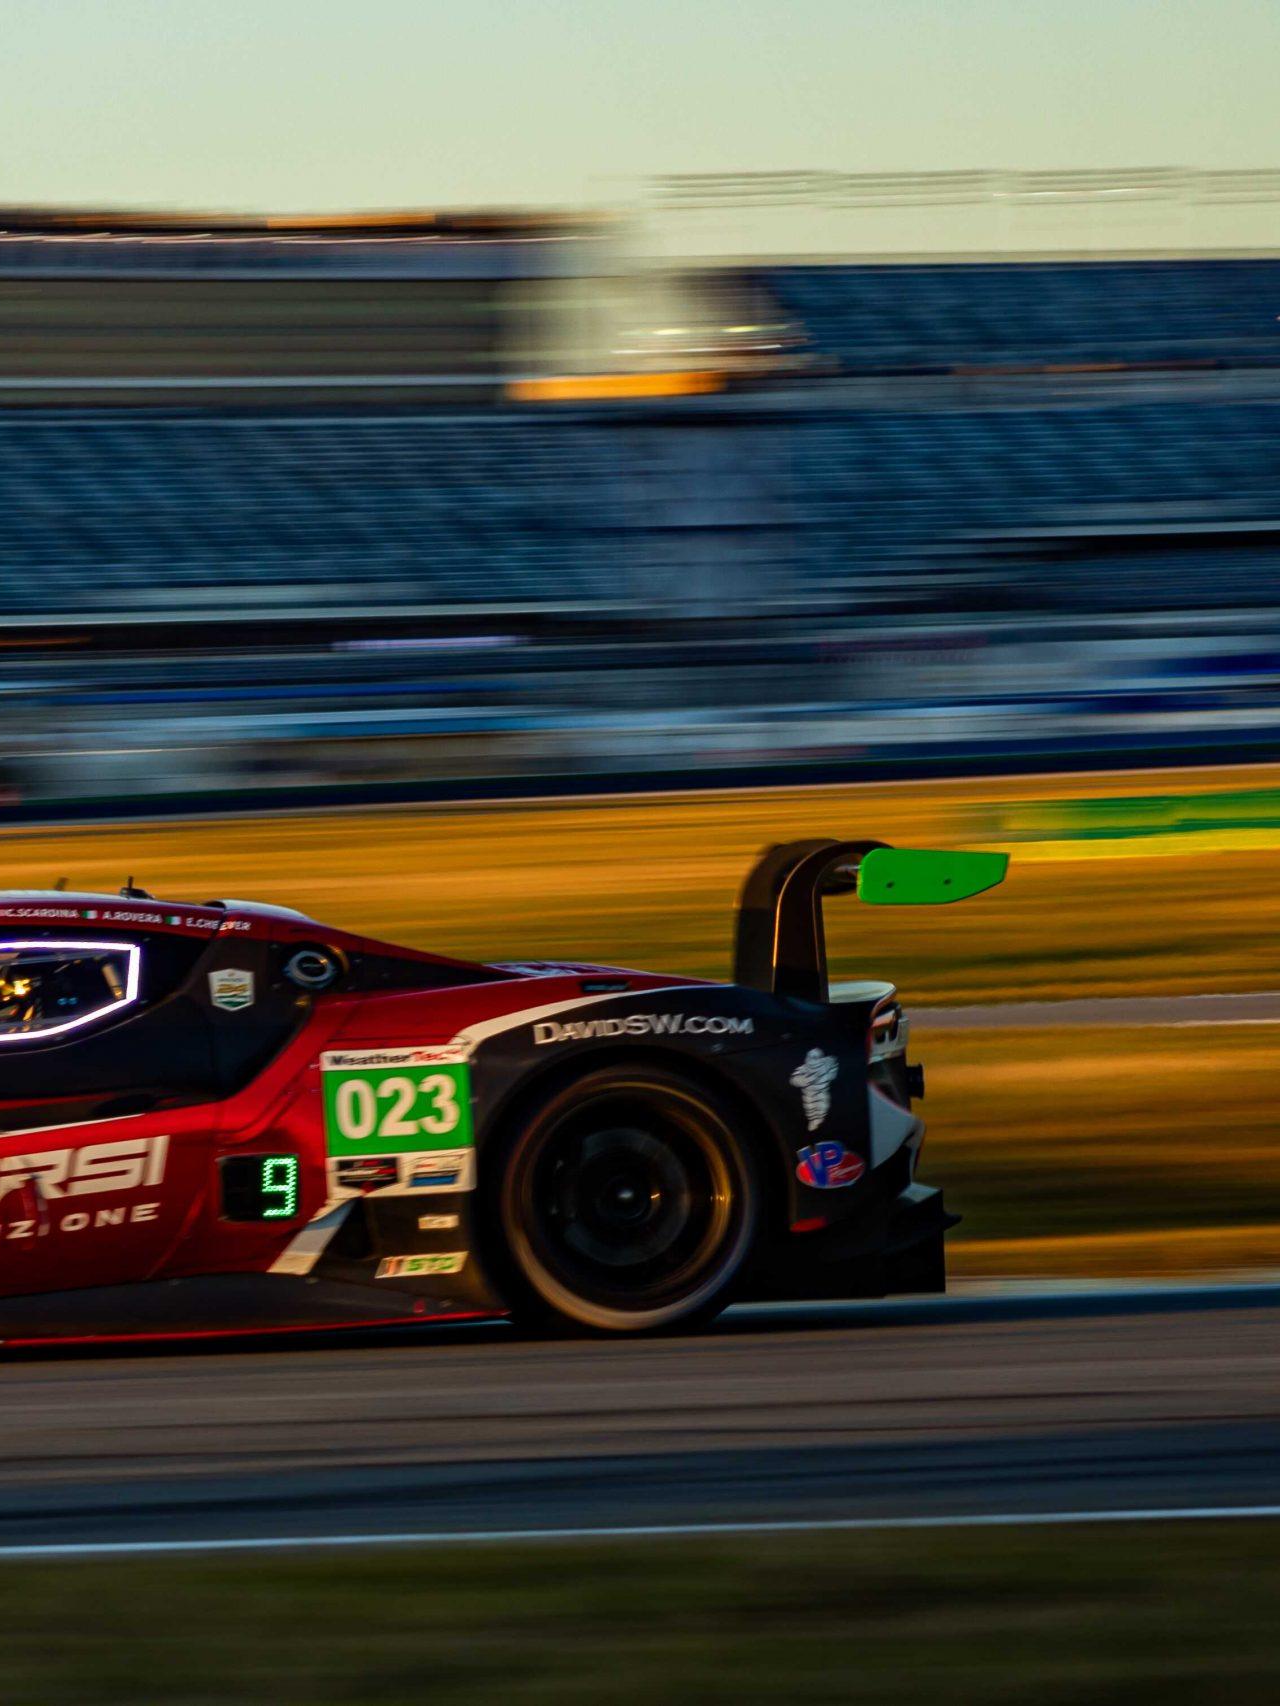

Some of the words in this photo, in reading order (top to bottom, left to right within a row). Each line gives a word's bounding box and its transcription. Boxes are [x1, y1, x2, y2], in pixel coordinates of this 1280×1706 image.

[102, 910, 162, 925] A.ROVERA
[335, 1073, 461, 1140] 023
[262, 1157, 297, 1216] 9
